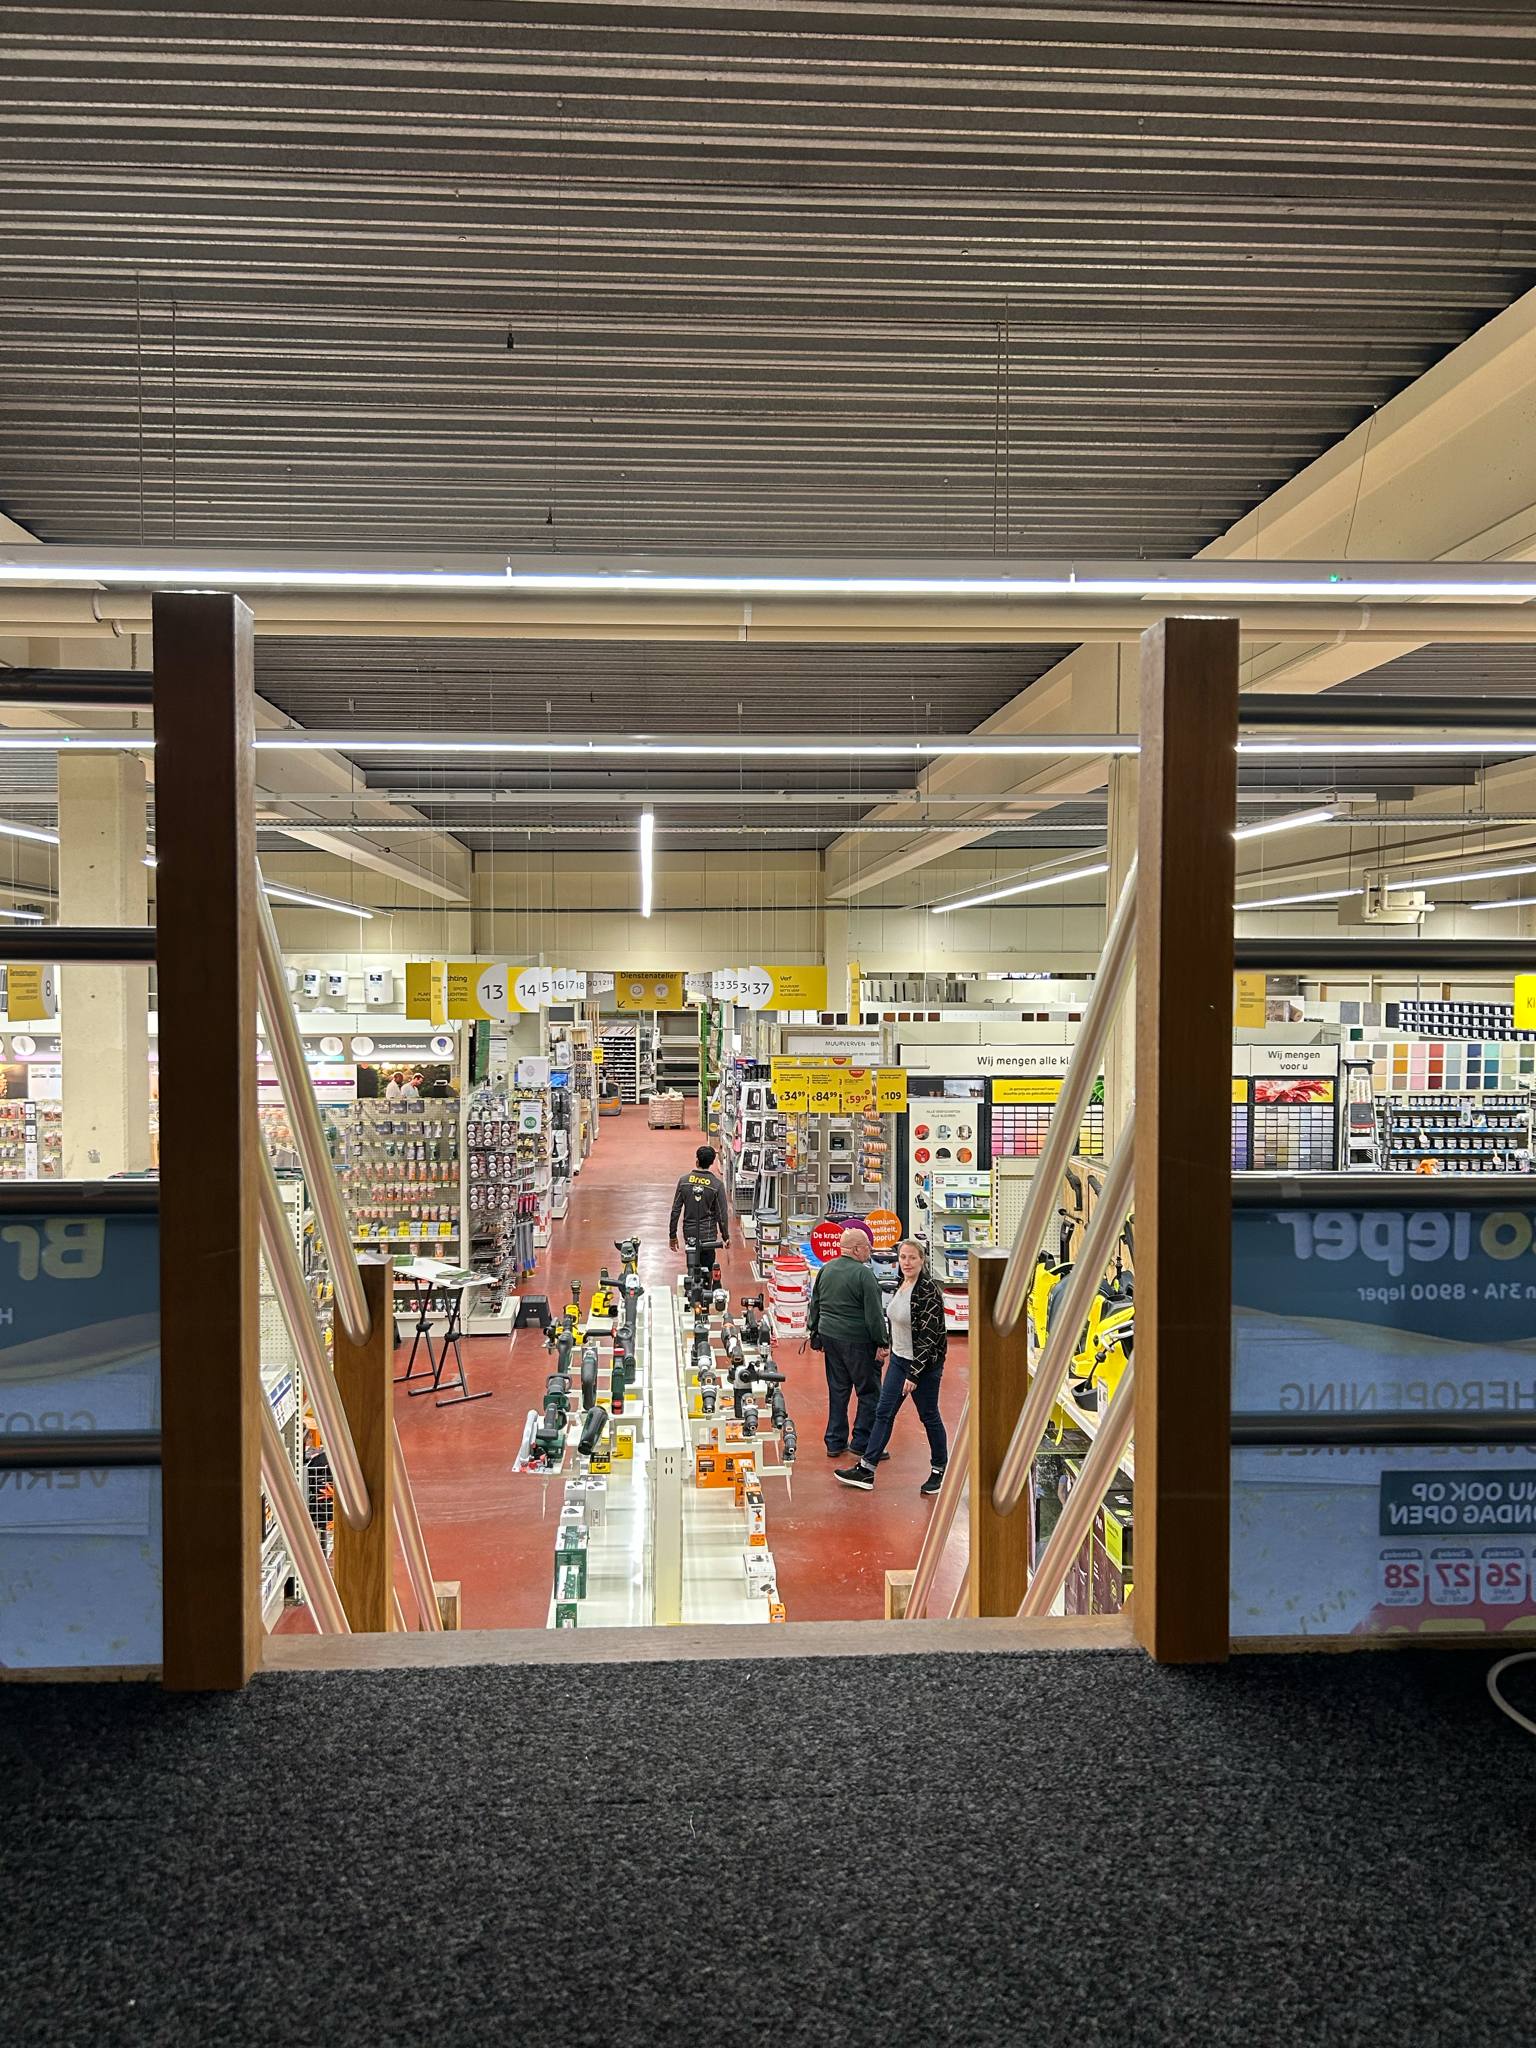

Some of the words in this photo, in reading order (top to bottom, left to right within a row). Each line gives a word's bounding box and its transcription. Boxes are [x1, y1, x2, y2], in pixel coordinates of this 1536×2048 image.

[620, 971, 678, 980] Dienstenatelier
[45, 979, 52, 997] 8
[552, 980, 564, 990] 16
[576, 981, 585, 989] 18
[726, 980, 739, 990] 35
[752, 983, 770, 995] 37
[482, 985, 504, 999] 13
[519, 984, 536, 997] 14
[1268, 1050, 1283, 1060] Wij
[1285, 1051, 1321, 1061] mengen
[977, 1055, 994, 1067] Wij
[996, 1057, 1037, 1067] mengen
[1039, 1055, 1057, 1066] alle
[688, 1175, 711, 1186] Brico
[813, 1231, 823, 1239] De
[832, 1240, 841, 1248] de
[822, 1248, 838, 1257] prijs
